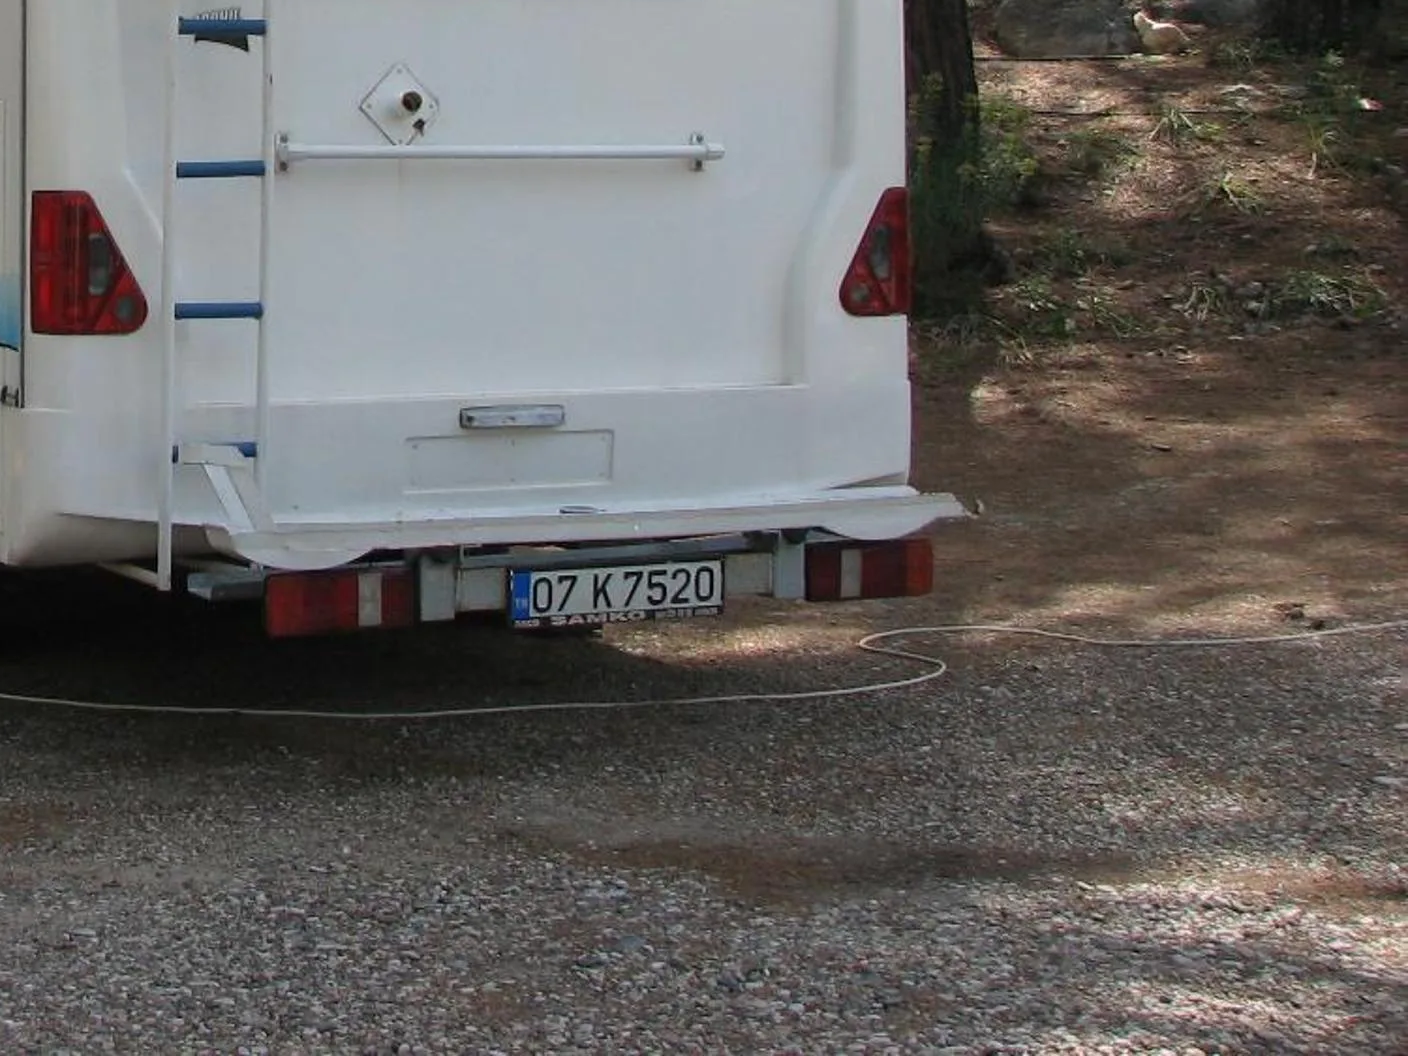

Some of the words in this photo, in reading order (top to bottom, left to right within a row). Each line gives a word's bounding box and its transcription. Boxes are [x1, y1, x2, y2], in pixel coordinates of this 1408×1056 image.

[532, 575, 578, 614] 07
[592, 572, 612, 609] K
[623, 566, 715, 607] 7520
[549, 610, 646, 627] SAMKO
